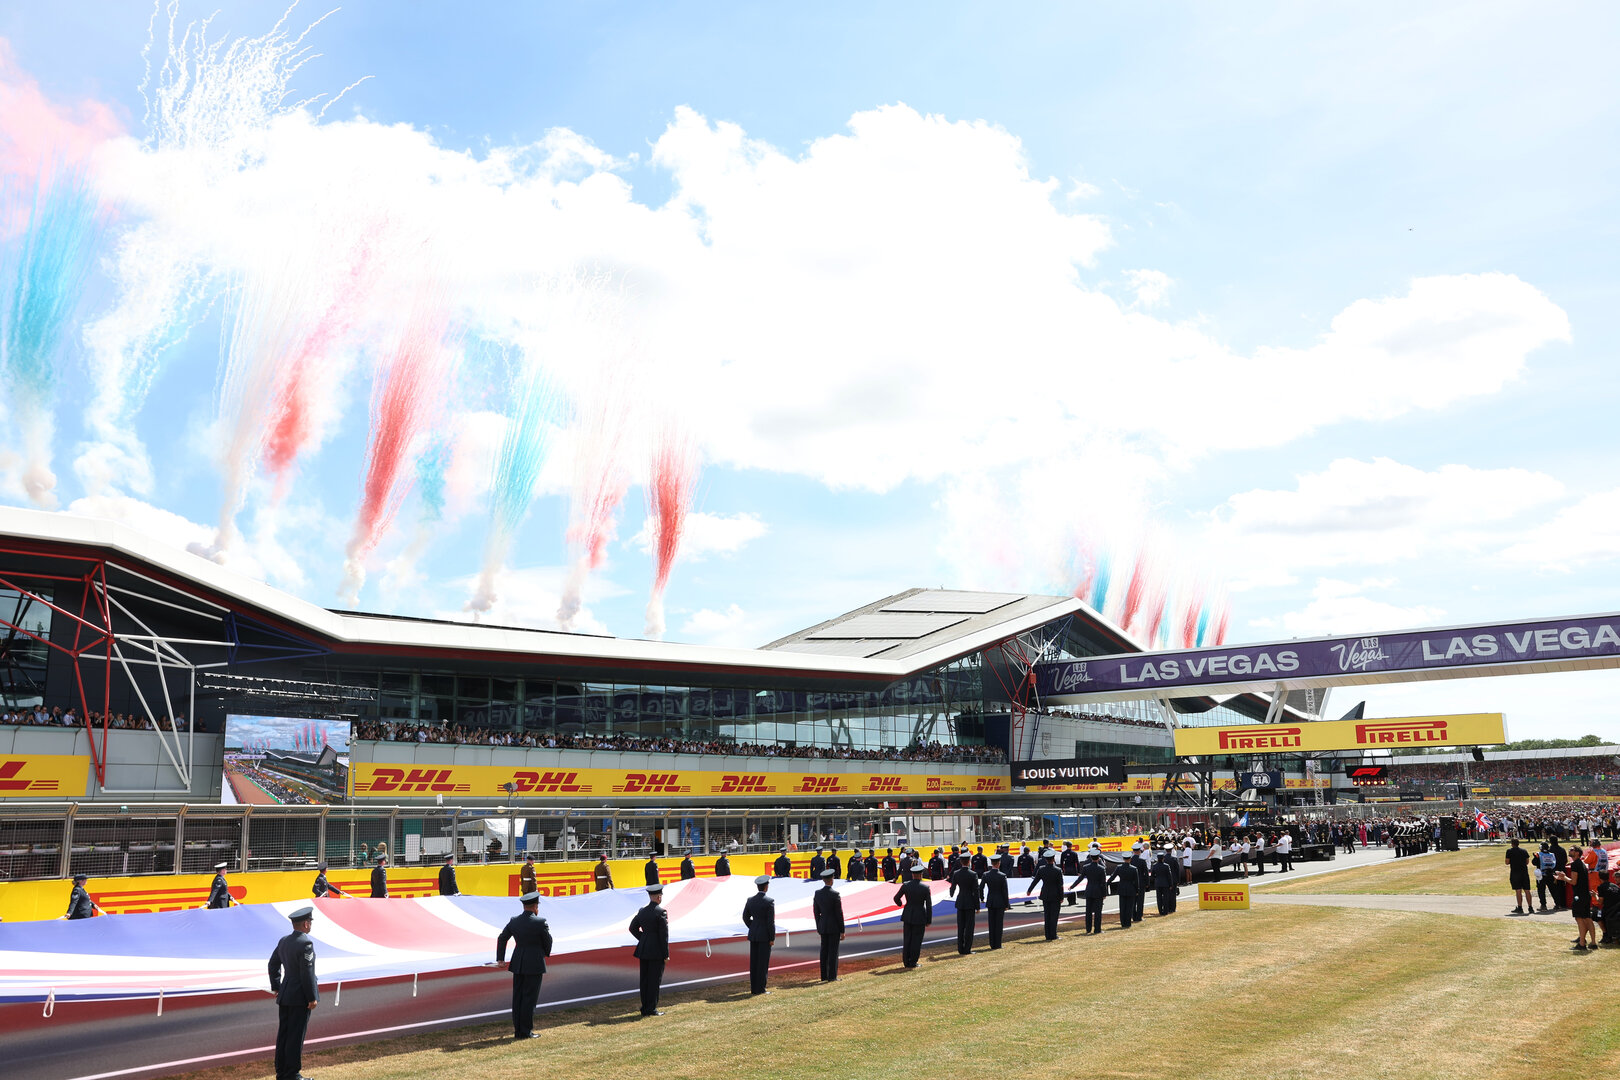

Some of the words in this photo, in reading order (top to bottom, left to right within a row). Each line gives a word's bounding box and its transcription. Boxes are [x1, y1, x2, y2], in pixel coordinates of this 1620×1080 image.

[1362, 638, 1378, 648] LAS
[1421, 634, 1499, 661] LAS
[1504, 624, 1620, 653] VEGA
[1331, 641, 1389, 671] Vegas
[1073, 663, 1086, 672] LAS
[1120, 661, 1180, 683] LAS
[1186, 651, 1300, 677] VEGAS
[1048, 665, 1093, 692] Vegas
[1218, 727, 1302, 750] PIRELLI
[1356, 720, 1448, 744] PIRELLI
[369, 768, 456, 792] DHL
[510, 771, 581, 792] DHL
[623, 773, 681, 793] DHL
[1023, 769, 1057, 780] LOUIS
[1058, 766, 1109, 778] VUITTON
[720, 775, 769, 793] DHL
[801, 776, 841, 793] DHL
[868, 776, 903, 792] DHL
[976, 778, 1001, 791] DHL
[1203, 891, 1244, 902] PIRELLI
